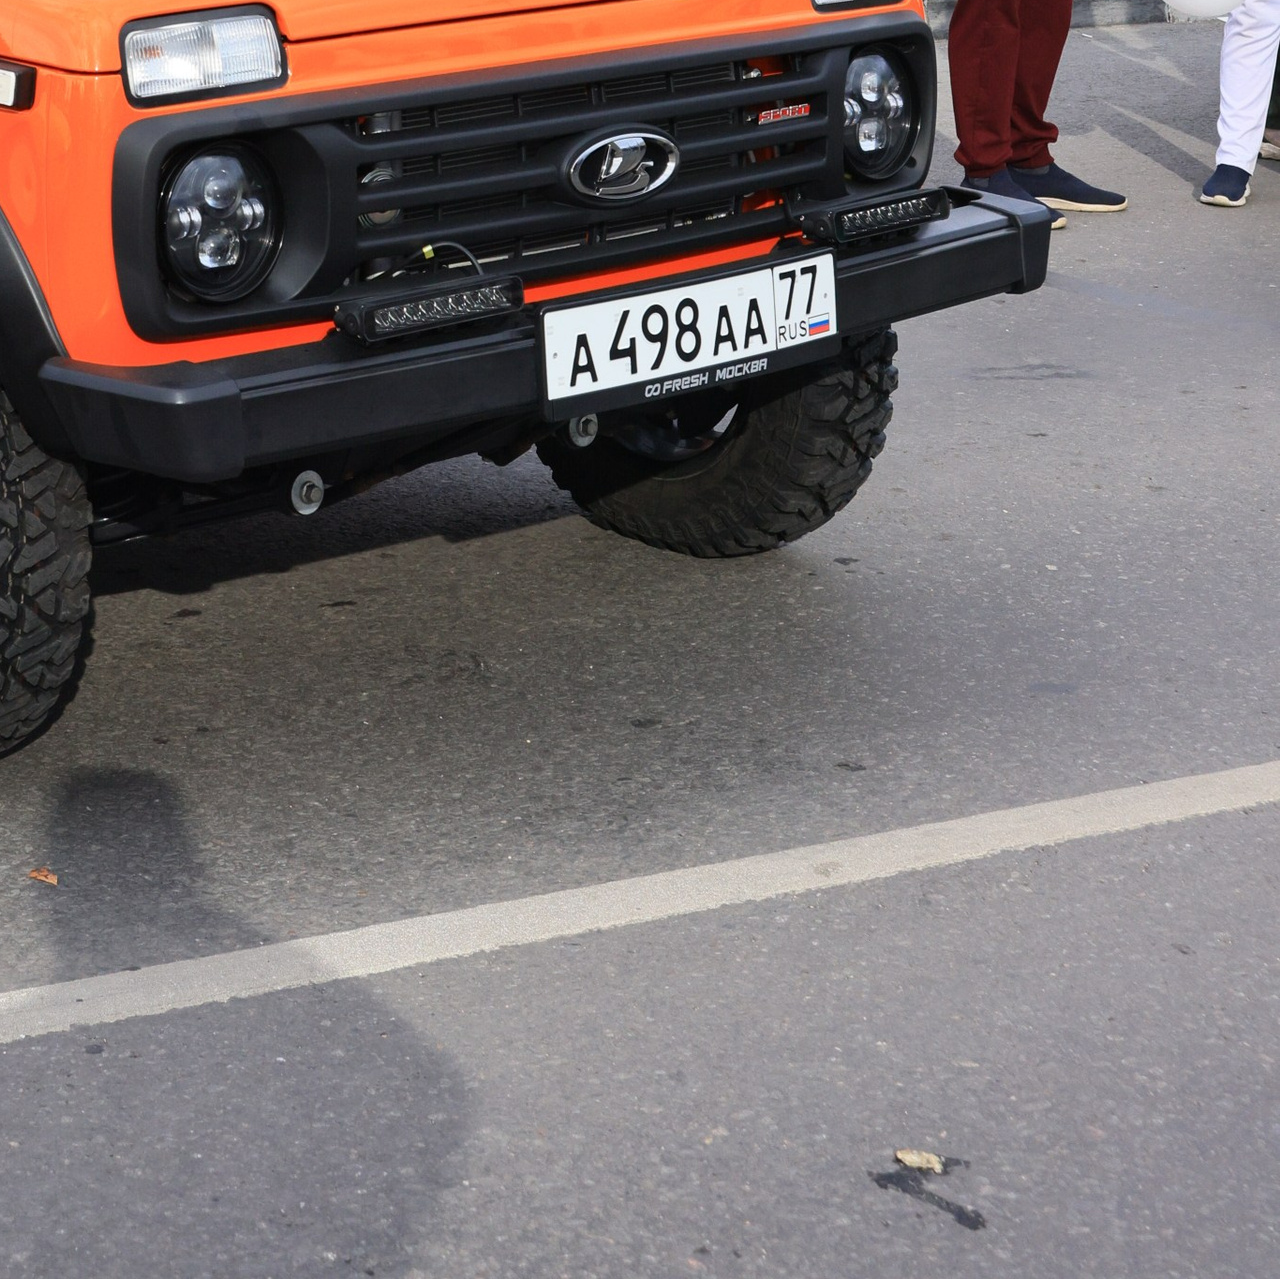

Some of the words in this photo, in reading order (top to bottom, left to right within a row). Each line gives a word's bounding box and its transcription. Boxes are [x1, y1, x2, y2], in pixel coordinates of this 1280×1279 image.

[760, 103, 810, 122] SPORT
[778, 264, 818, 320] 77
[778, 319, 808, 343] RUS
